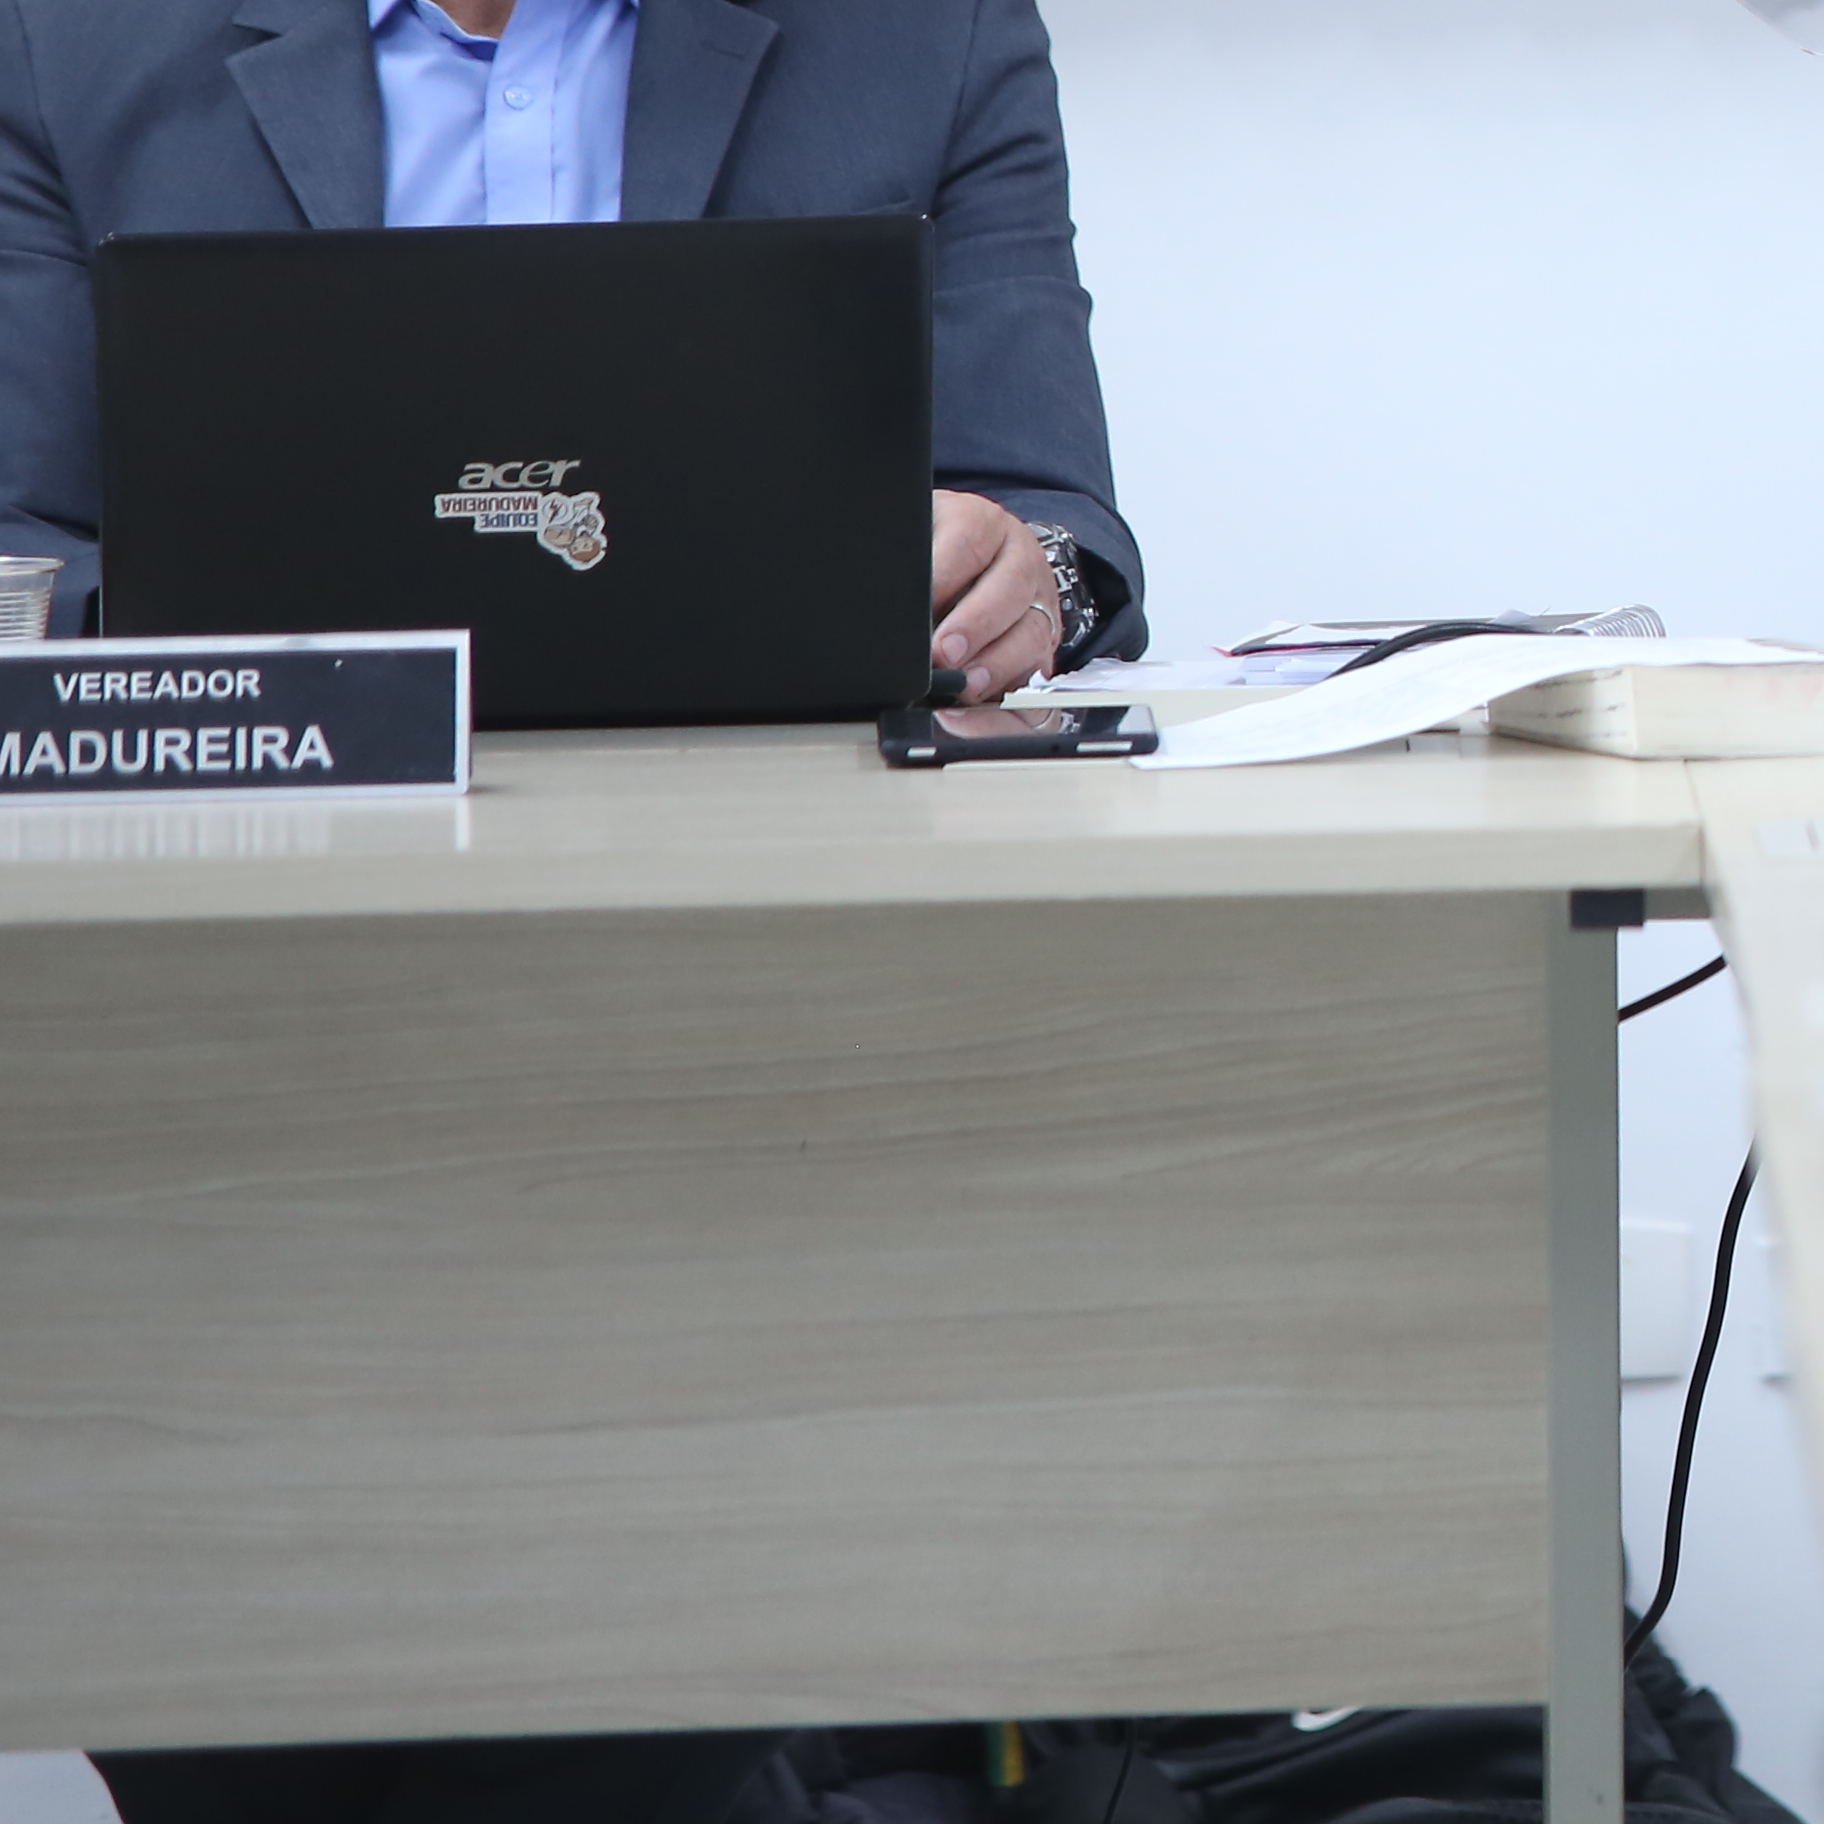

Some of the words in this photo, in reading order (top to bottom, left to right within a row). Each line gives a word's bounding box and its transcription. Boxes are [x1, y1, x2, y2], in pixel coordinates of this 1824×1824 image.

[458, 459, 581, 489] acer
[441, 496, 538, 513] MADUREIRA
[480, 513, 538, 529] EQUIPE
[53, 669, 261, 702] VEREADOR
